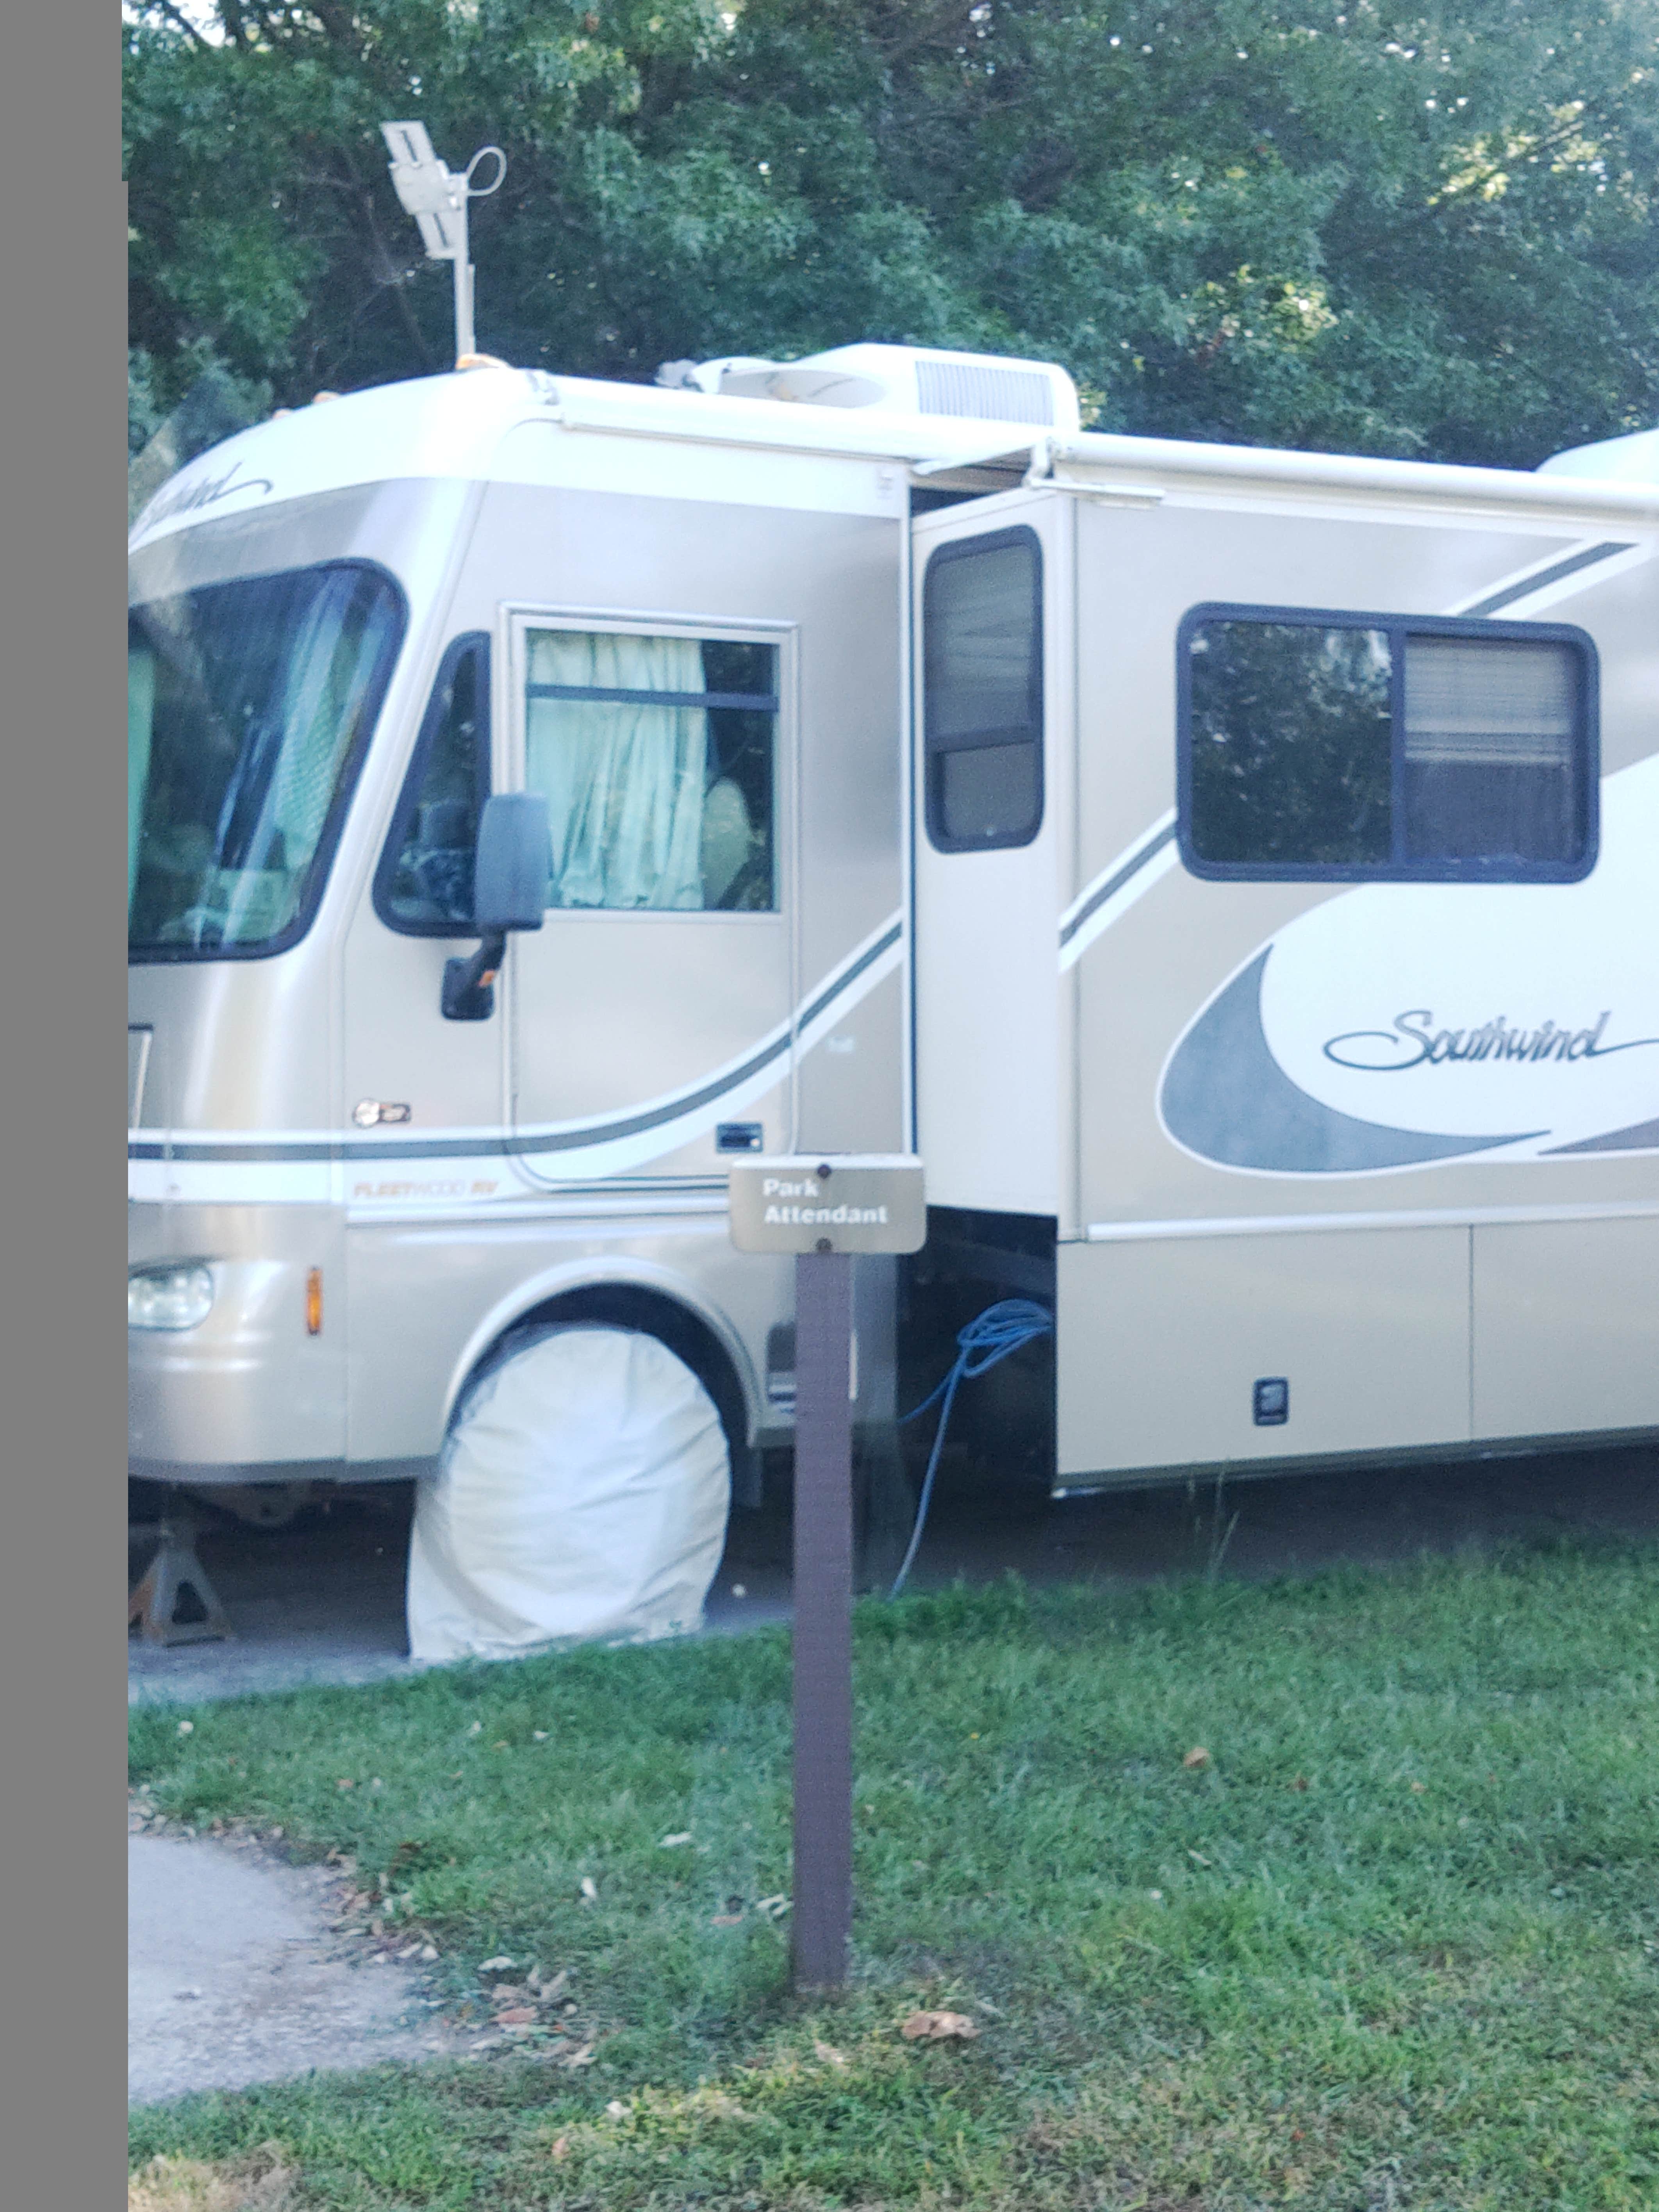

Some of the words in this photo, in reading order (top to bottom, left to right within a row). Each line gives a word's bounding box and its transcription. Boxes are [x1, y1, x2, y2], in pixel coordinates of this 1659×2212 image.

[1323, 1010, 1659, 1071] Southwind
[763, 1179, 818, 1197] Park
[764, 1205, 888, 1224] Attendant
